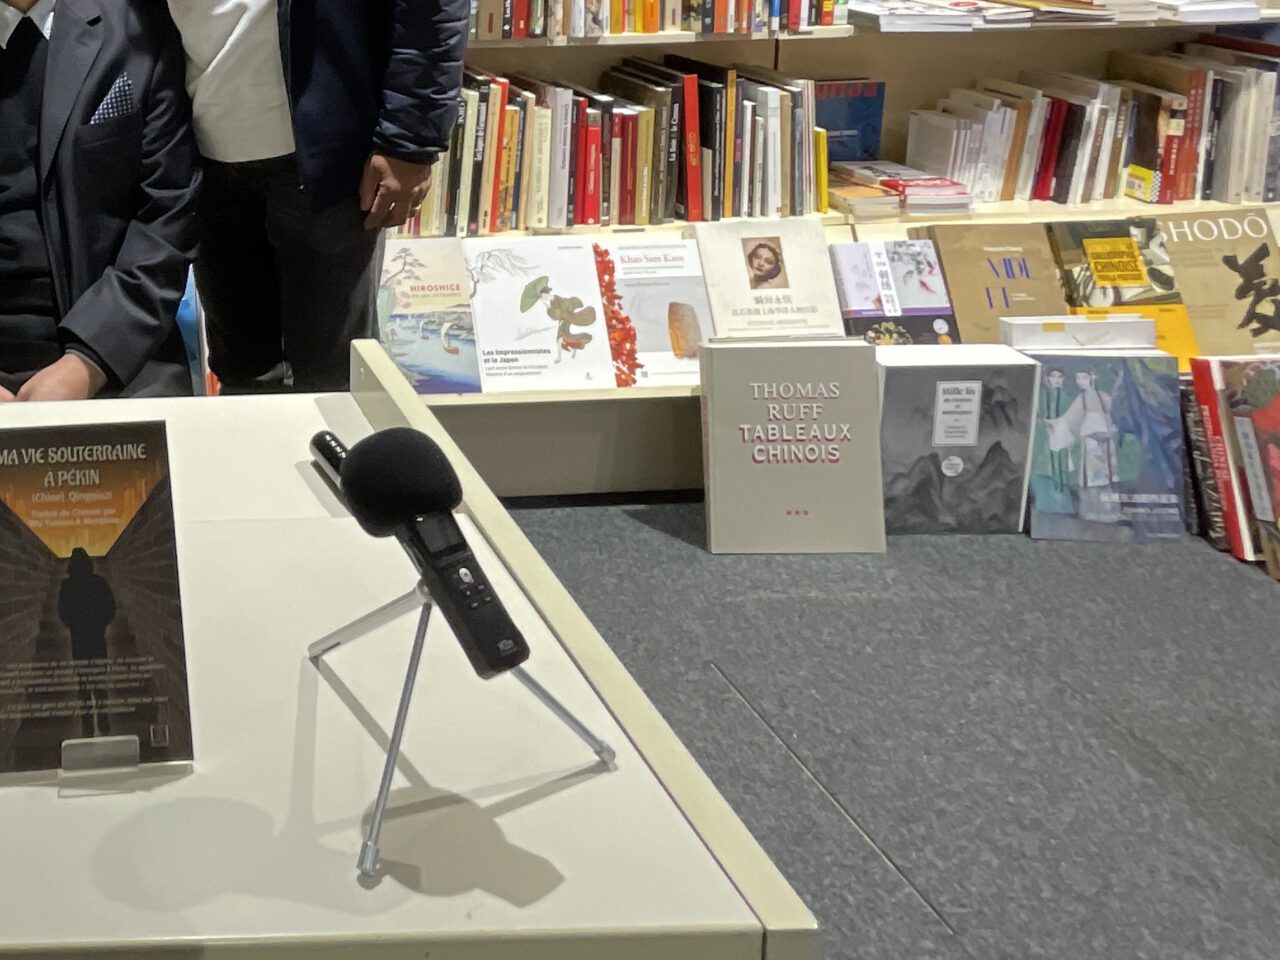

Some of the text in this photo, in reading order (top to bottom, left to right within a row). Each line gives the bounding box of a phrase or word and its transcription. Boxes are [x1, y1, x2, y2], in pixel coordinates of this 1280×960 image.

[499, 356, 520, 364] Japon
[750, 382, 841, 400] THOMAS
[768, 402, 824, 421] RUFF
[739, 423, 852, 443] TABLEAUX
[21, 447, 45, 464] VIE
[47, 443, 147, 464] SOUTERRAINE
[752, 444, 840, 464] CHINOIS
[43, 468, 100, 488] À PÉKIN
